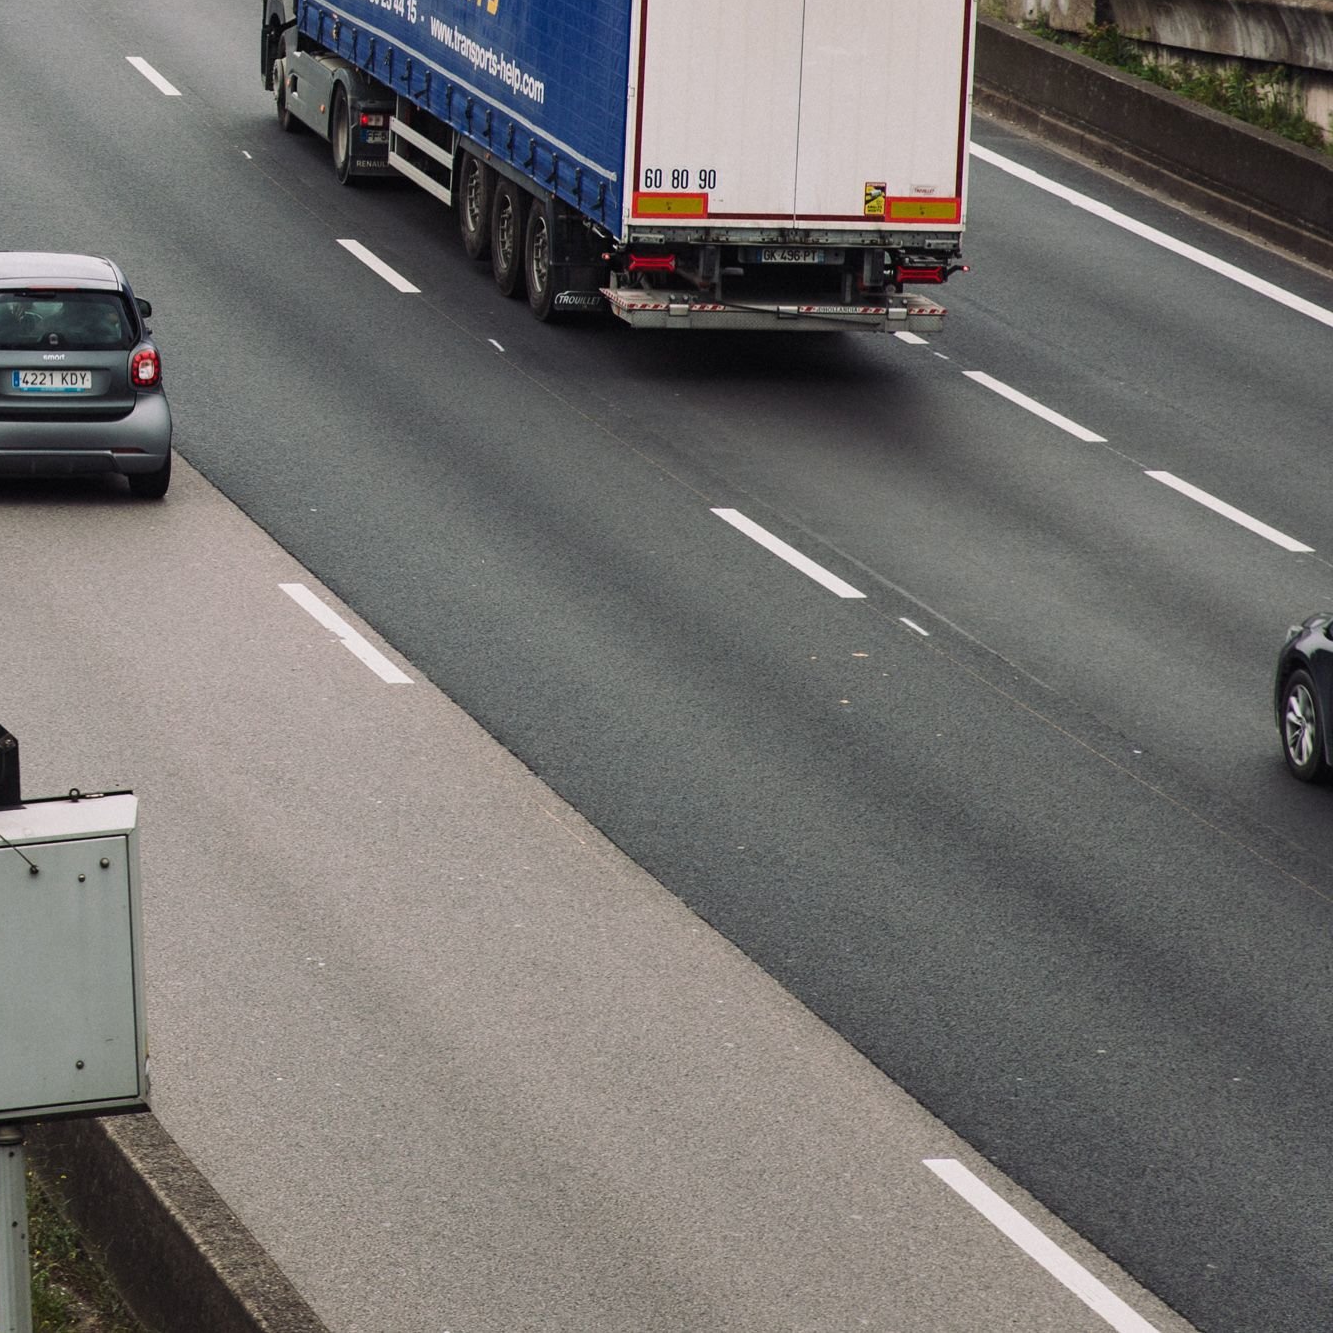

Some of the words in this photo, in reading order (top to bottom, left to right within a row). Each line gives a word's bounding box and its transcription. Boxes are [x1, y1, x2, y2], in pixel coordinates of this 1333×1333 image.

[430, 16, 545, 104] www.transports-help.com
[644, 169, 662, 189] 60
[671, 169, 689, 189] 80
[698, 169, 717, 189] 90
[559, 294, 602, 306] TROUILLET
[22, 372, 53, 385] 4221
[61, 372, 87, 385] KDY
